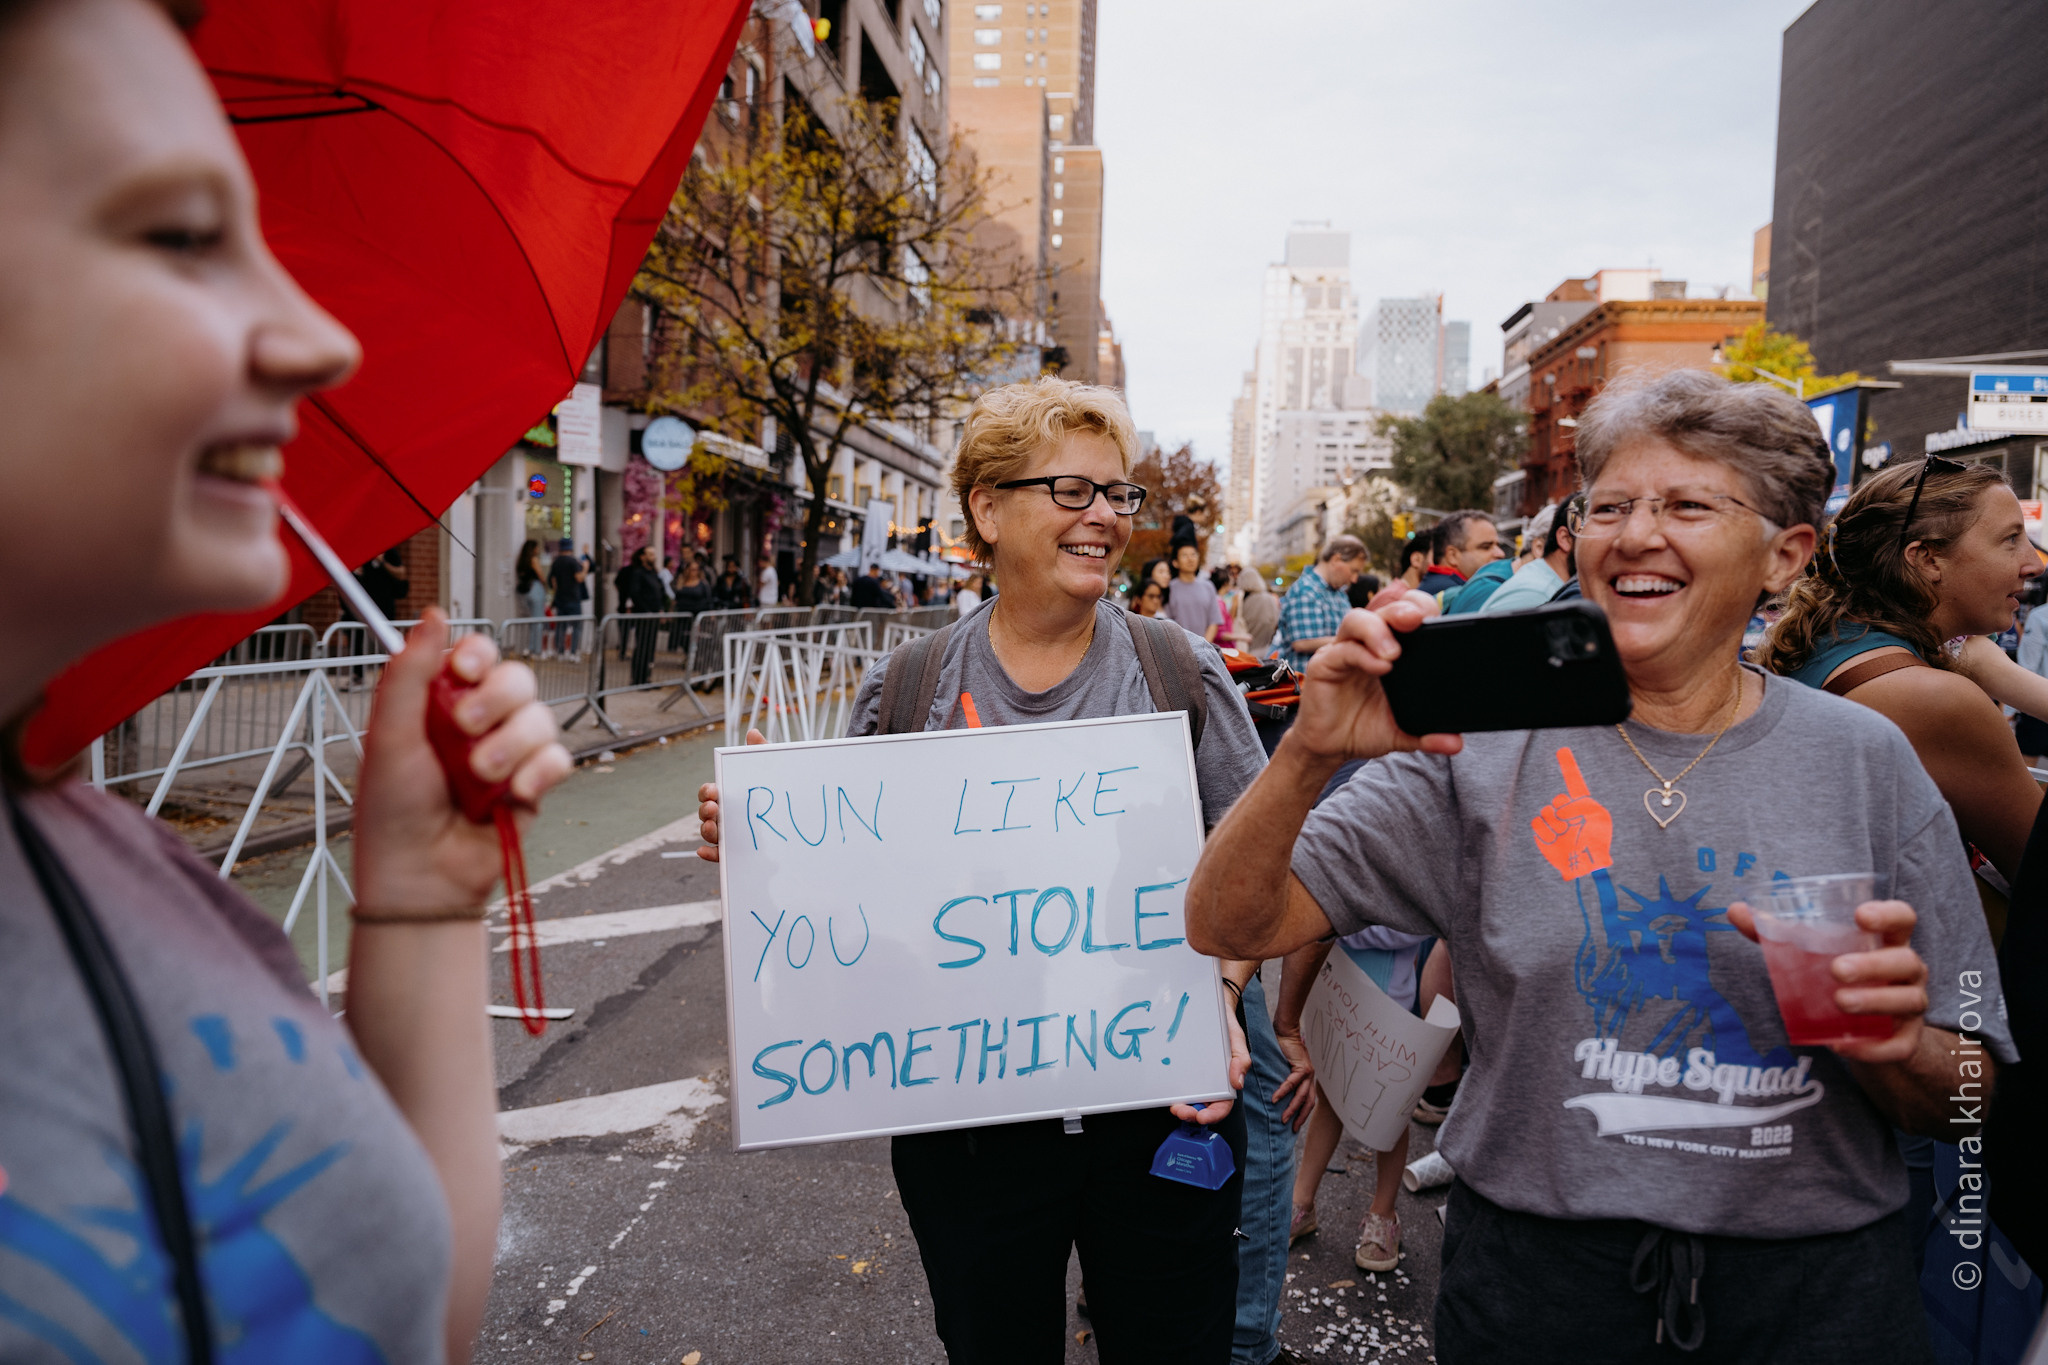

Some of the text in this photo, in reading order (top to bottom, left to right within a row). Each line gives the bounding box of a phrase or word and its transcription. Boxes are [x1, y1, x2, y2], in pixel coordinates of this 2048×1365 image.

[747, 766, 1139, 851] RUN LIKE
[751, 877, 1188, 982] YOU STOLE
[751, 991, 1190, 1111] SOMETHING!
[1364, 1021, 1417, 1067] WITH
[1574, 1038, 1815, 1106] Hype Squad
[1622, 1134, 1792, 1159] TCS NEW YORK CITY MARATHON
[1751, 1124, 1793, 1147] 2022
